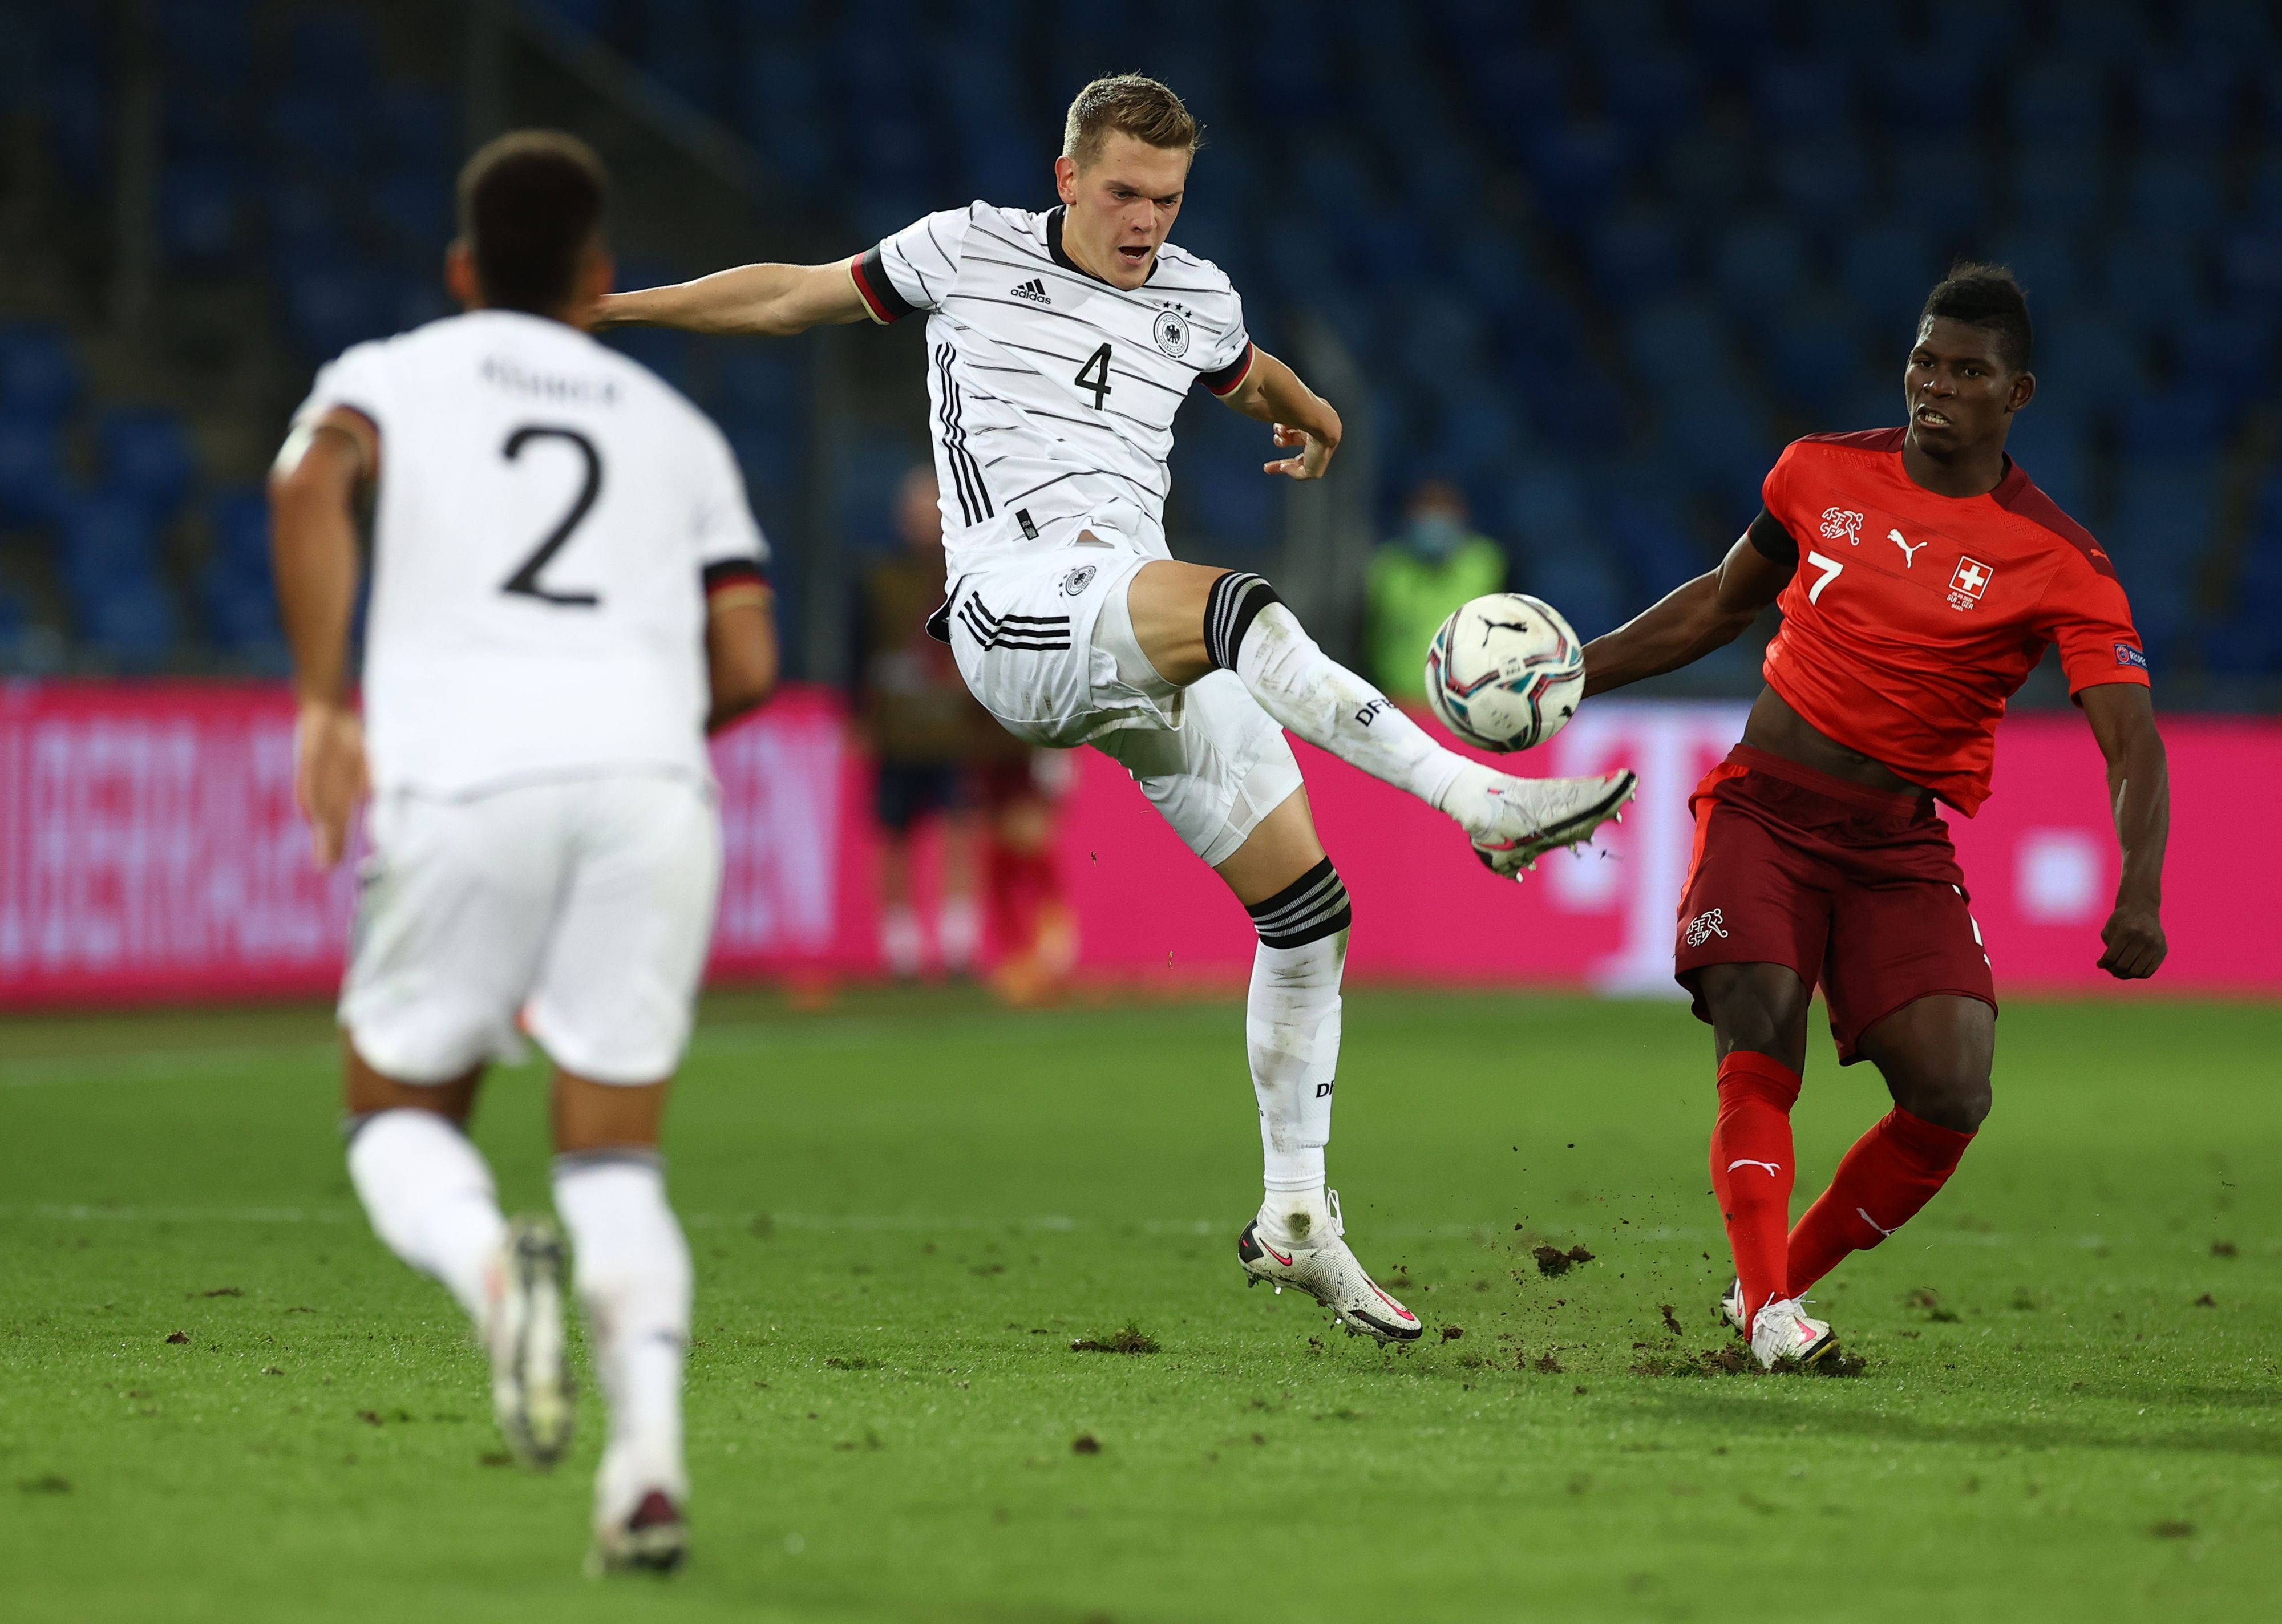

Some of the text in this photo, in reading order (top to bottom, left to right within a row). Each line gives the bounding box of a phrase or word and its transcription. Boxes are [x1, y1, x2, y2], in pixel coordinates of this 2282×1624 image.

[1010, 289, 1051, 305] adidas
[1074, 342, 1112, 411] 4
[502, 425, 602, 605] 2
[1807, 550, 1844, 606] 7
[1961, 601, 1974, 610] GER
